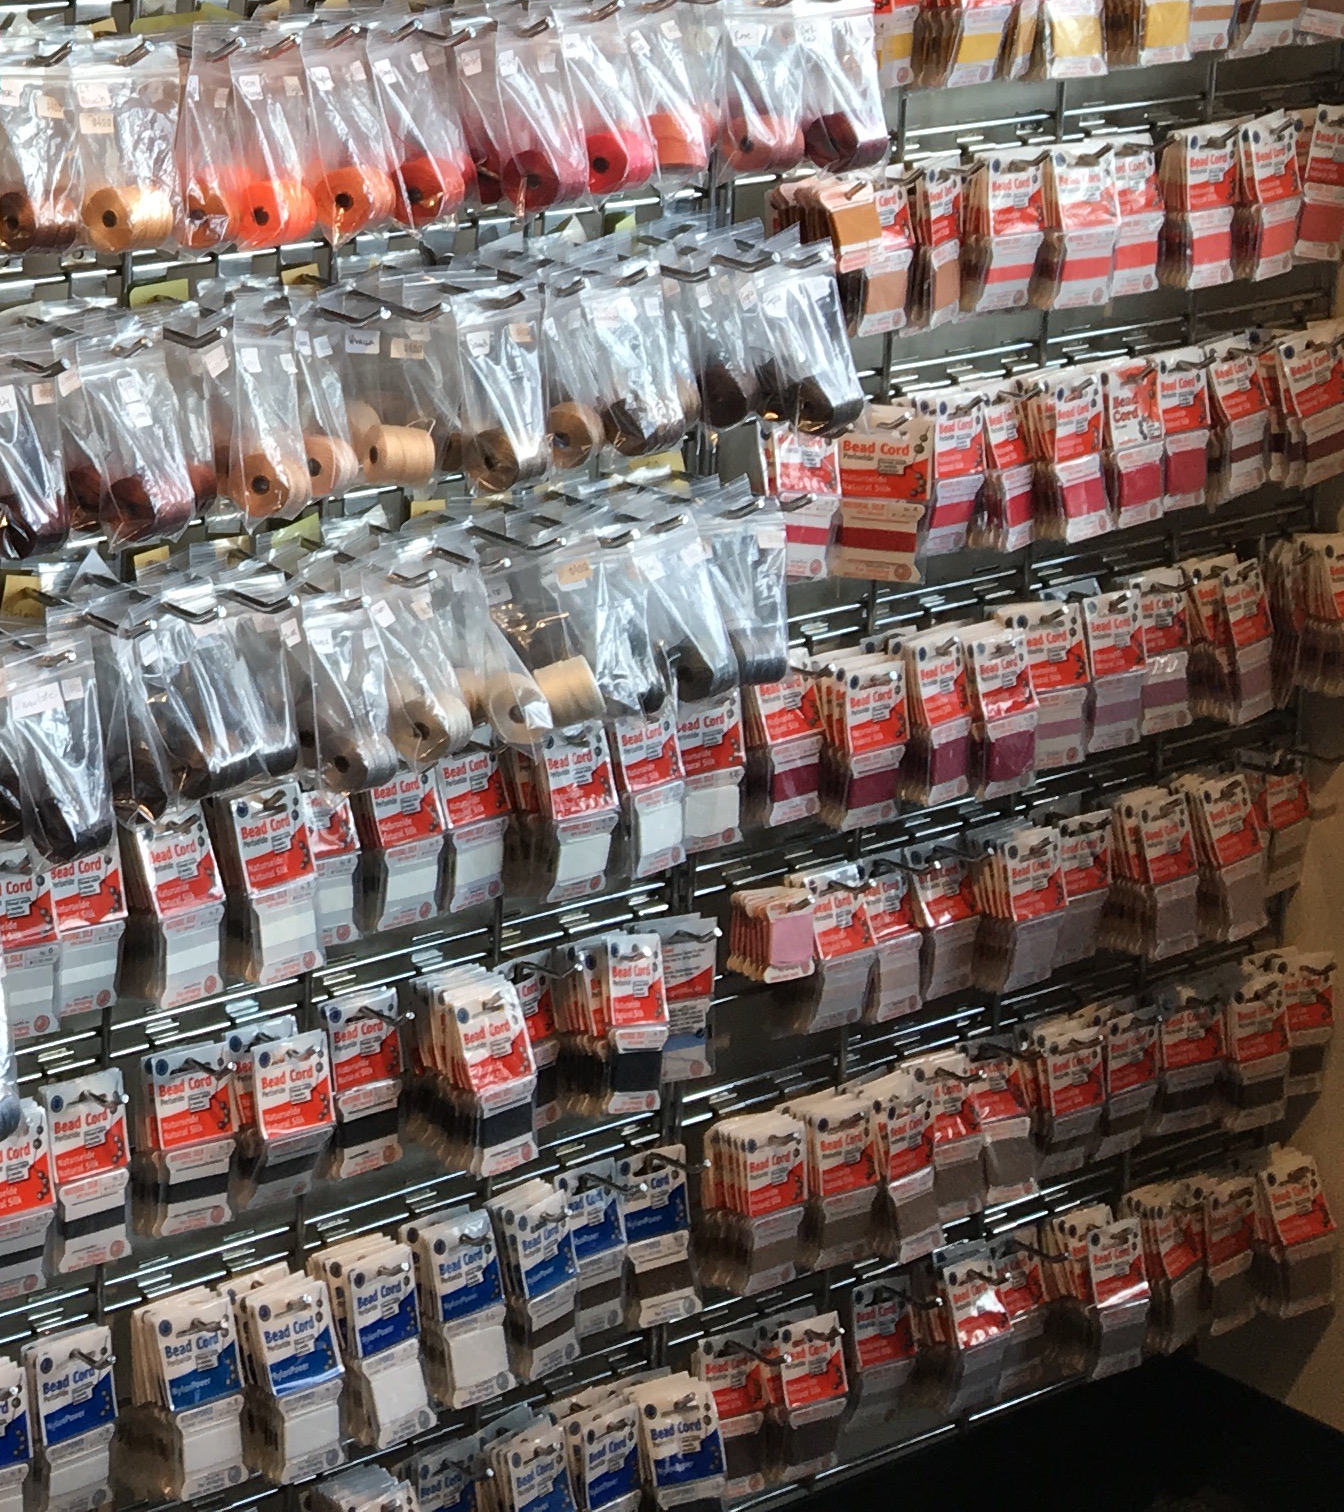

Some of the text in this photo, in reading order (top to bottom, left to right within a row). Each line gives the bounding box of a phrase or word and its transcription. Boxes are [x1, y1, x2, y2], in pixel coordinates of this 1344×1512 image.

[842, 439, 911, 457] Bead Cord
[241, 815, 292, 839] Bead Cord
[5, 877, 33, 895] Cord
[6, 1142, 31, 1162] Cord
